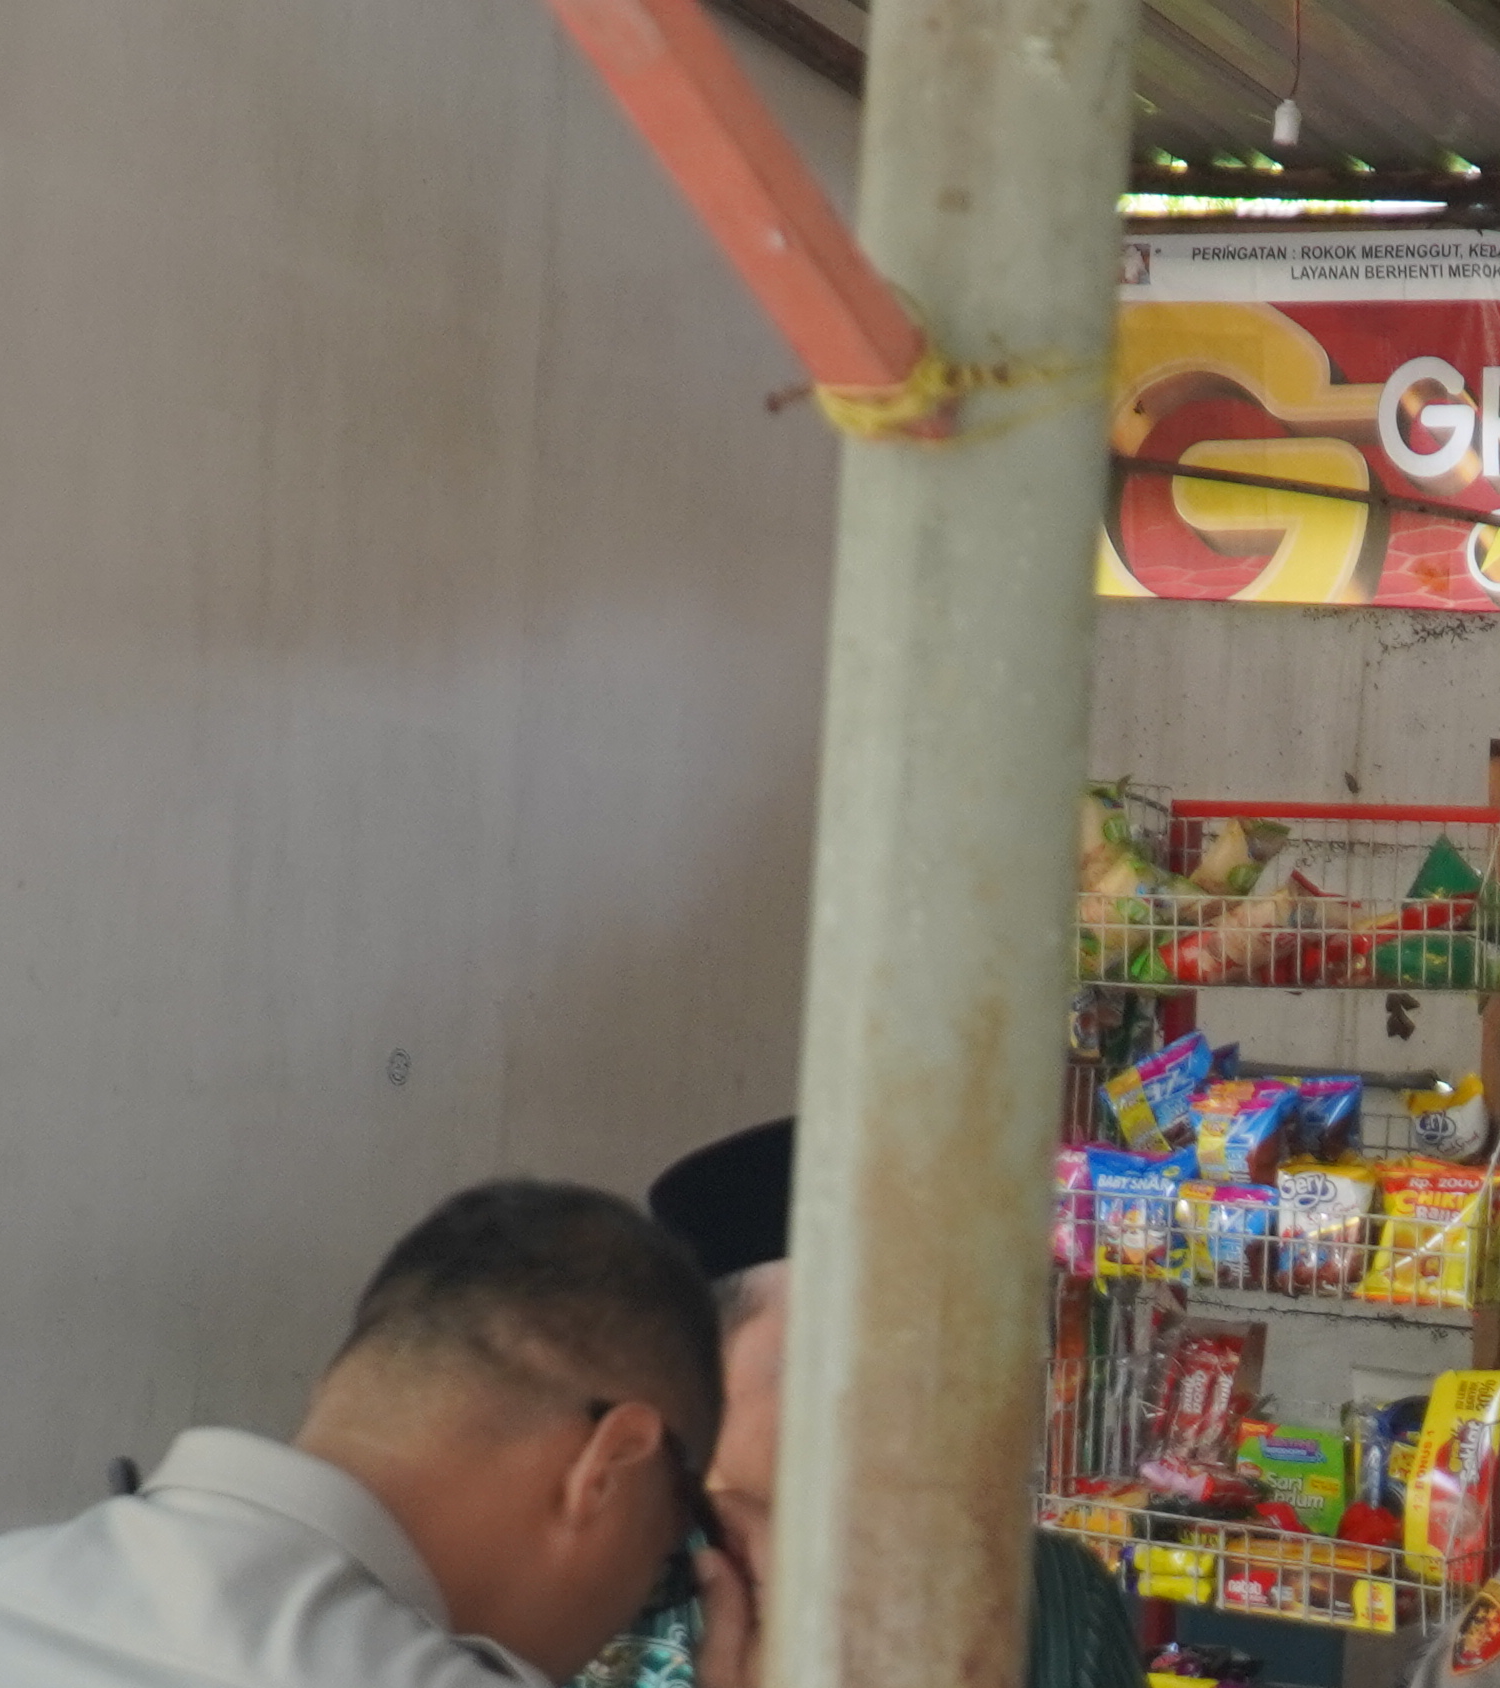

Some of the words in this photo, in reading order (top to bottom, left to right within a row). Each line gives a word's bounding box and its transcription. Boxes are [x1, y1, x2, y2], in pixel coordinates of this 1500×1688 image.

[1191, 246, 1287, 261] PERINGATAN
[1300, 245, 1357, 261] ROKOK
[1361, 244, 1464, 261] MERENGGUT,
[1290, 264, 1359, 281] LAYANAN
[1364, 263, 1444, 280] BERHENTI
[1267, 1474, 1304, 1492] Sari
